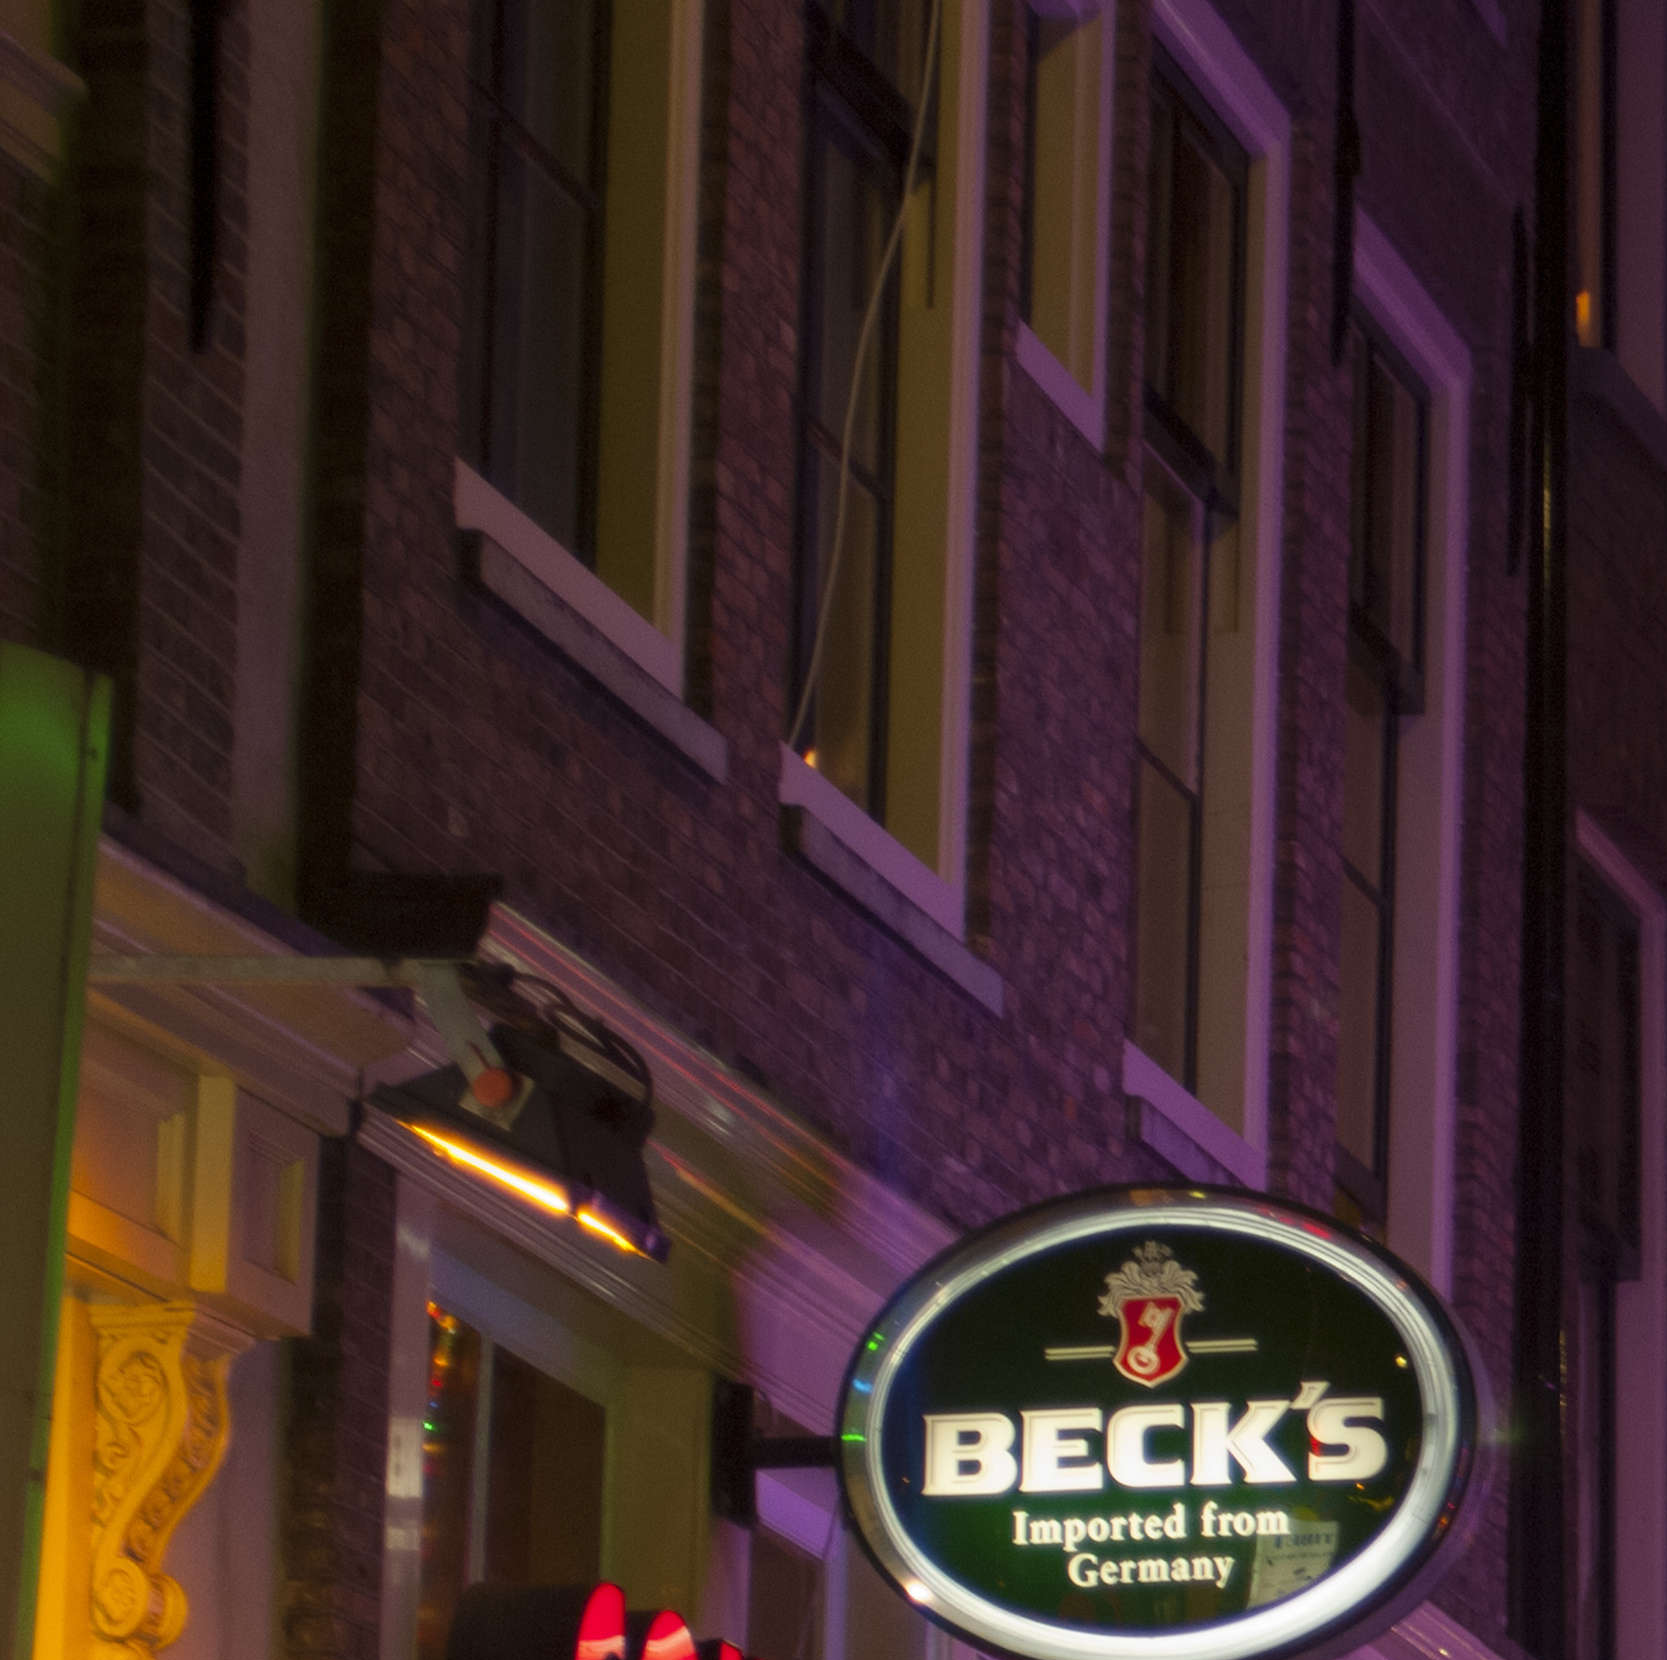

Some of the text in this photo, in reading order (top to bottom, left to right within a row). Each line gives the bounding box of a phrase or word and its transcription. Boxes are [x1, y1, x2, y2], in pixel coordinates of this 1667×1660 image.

[921, 1381, 1389, 1496] BECK'S
[1011, 1500, 1290, 1551] Imported from
[1067, 1552, 1236, 1590] Germany
